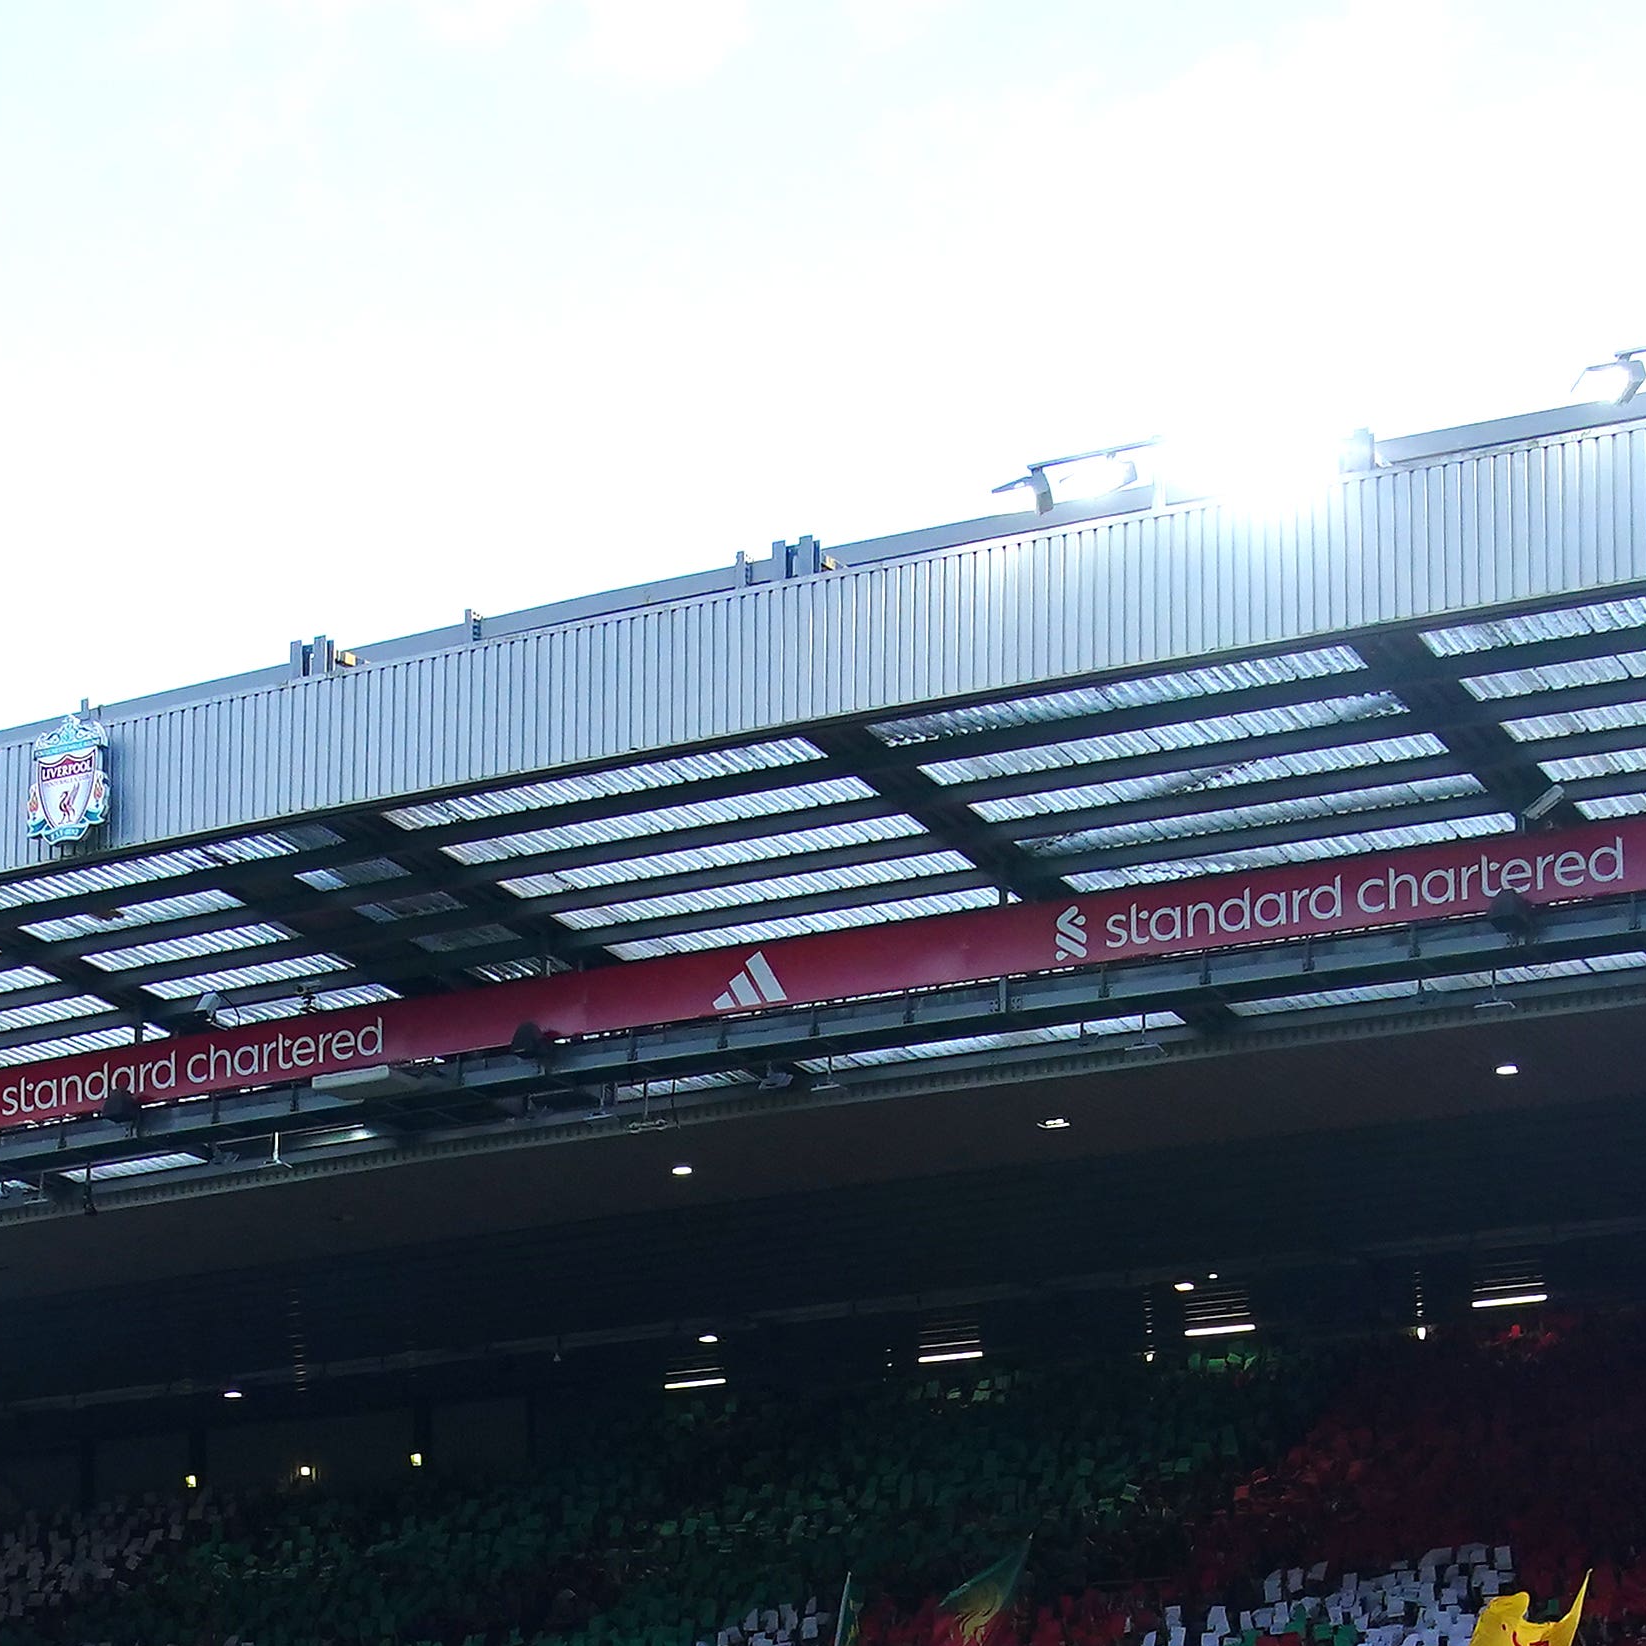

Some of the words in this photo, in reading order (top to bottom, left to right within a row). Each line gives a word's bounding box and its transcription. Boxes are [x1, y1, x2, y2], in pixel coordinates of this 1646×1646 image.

[41, 760, 92, 781] LIVERPOOL
[1105, 874, 1343, 950] standard
[1357, 836, 1625, 914] chartered
[1, 1050, 176, 1117] standard
[187, 1016, 383, 1082] chartered
